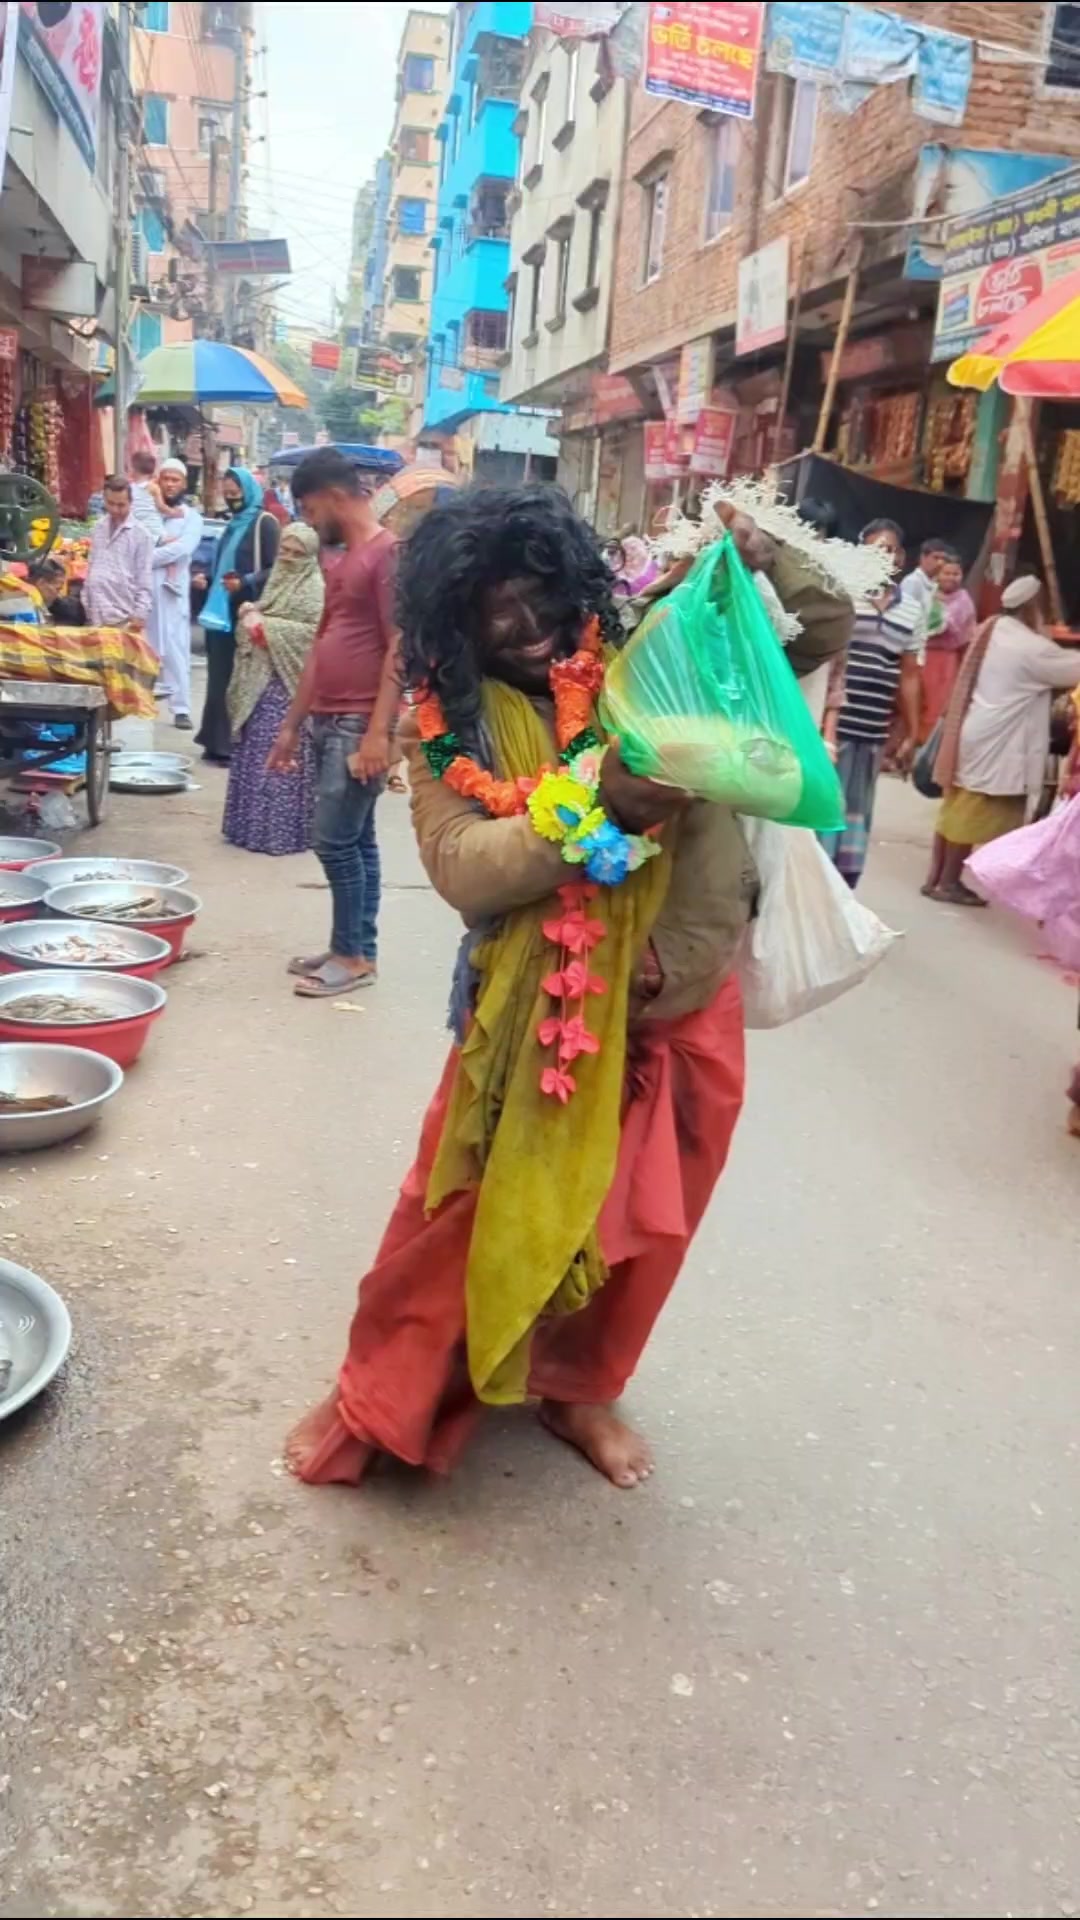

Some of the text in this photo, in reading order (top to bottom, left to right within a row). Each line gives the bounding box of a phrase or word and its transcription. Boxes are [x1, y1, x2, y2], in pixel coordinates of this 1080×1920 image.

[652, 22, 692, 51] ভর্তি
[697, 35, 757, 69] চলছে
[985, 256, 1036, 294] ভর্তি
[976, 285, 1033, 319] চলছে
